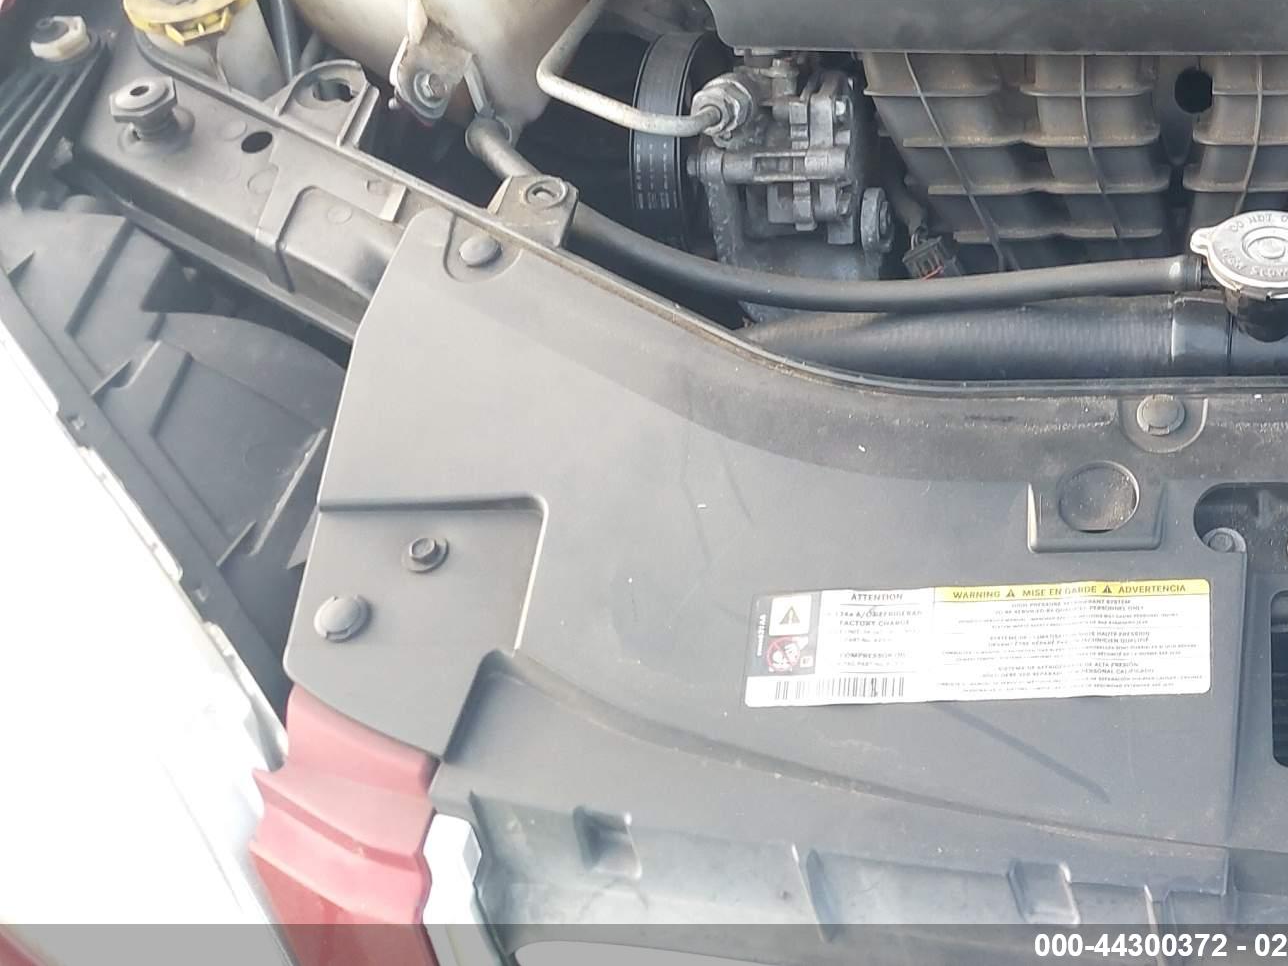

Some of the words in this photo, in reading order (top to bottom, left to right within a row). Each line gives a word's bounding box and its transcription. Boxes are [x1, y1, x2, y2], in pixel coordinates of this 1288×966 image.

[1247, 212, 1273, 225] NOT
[850, 593, 905, 602] ATTENTION
[952, 590, 1001, 600] WARNING
[1022, 588, 1045, 597] MISE
[1049, 587, 1062, 596] EN
[1118, 584, 1187, 594] ADVERTENCIA
